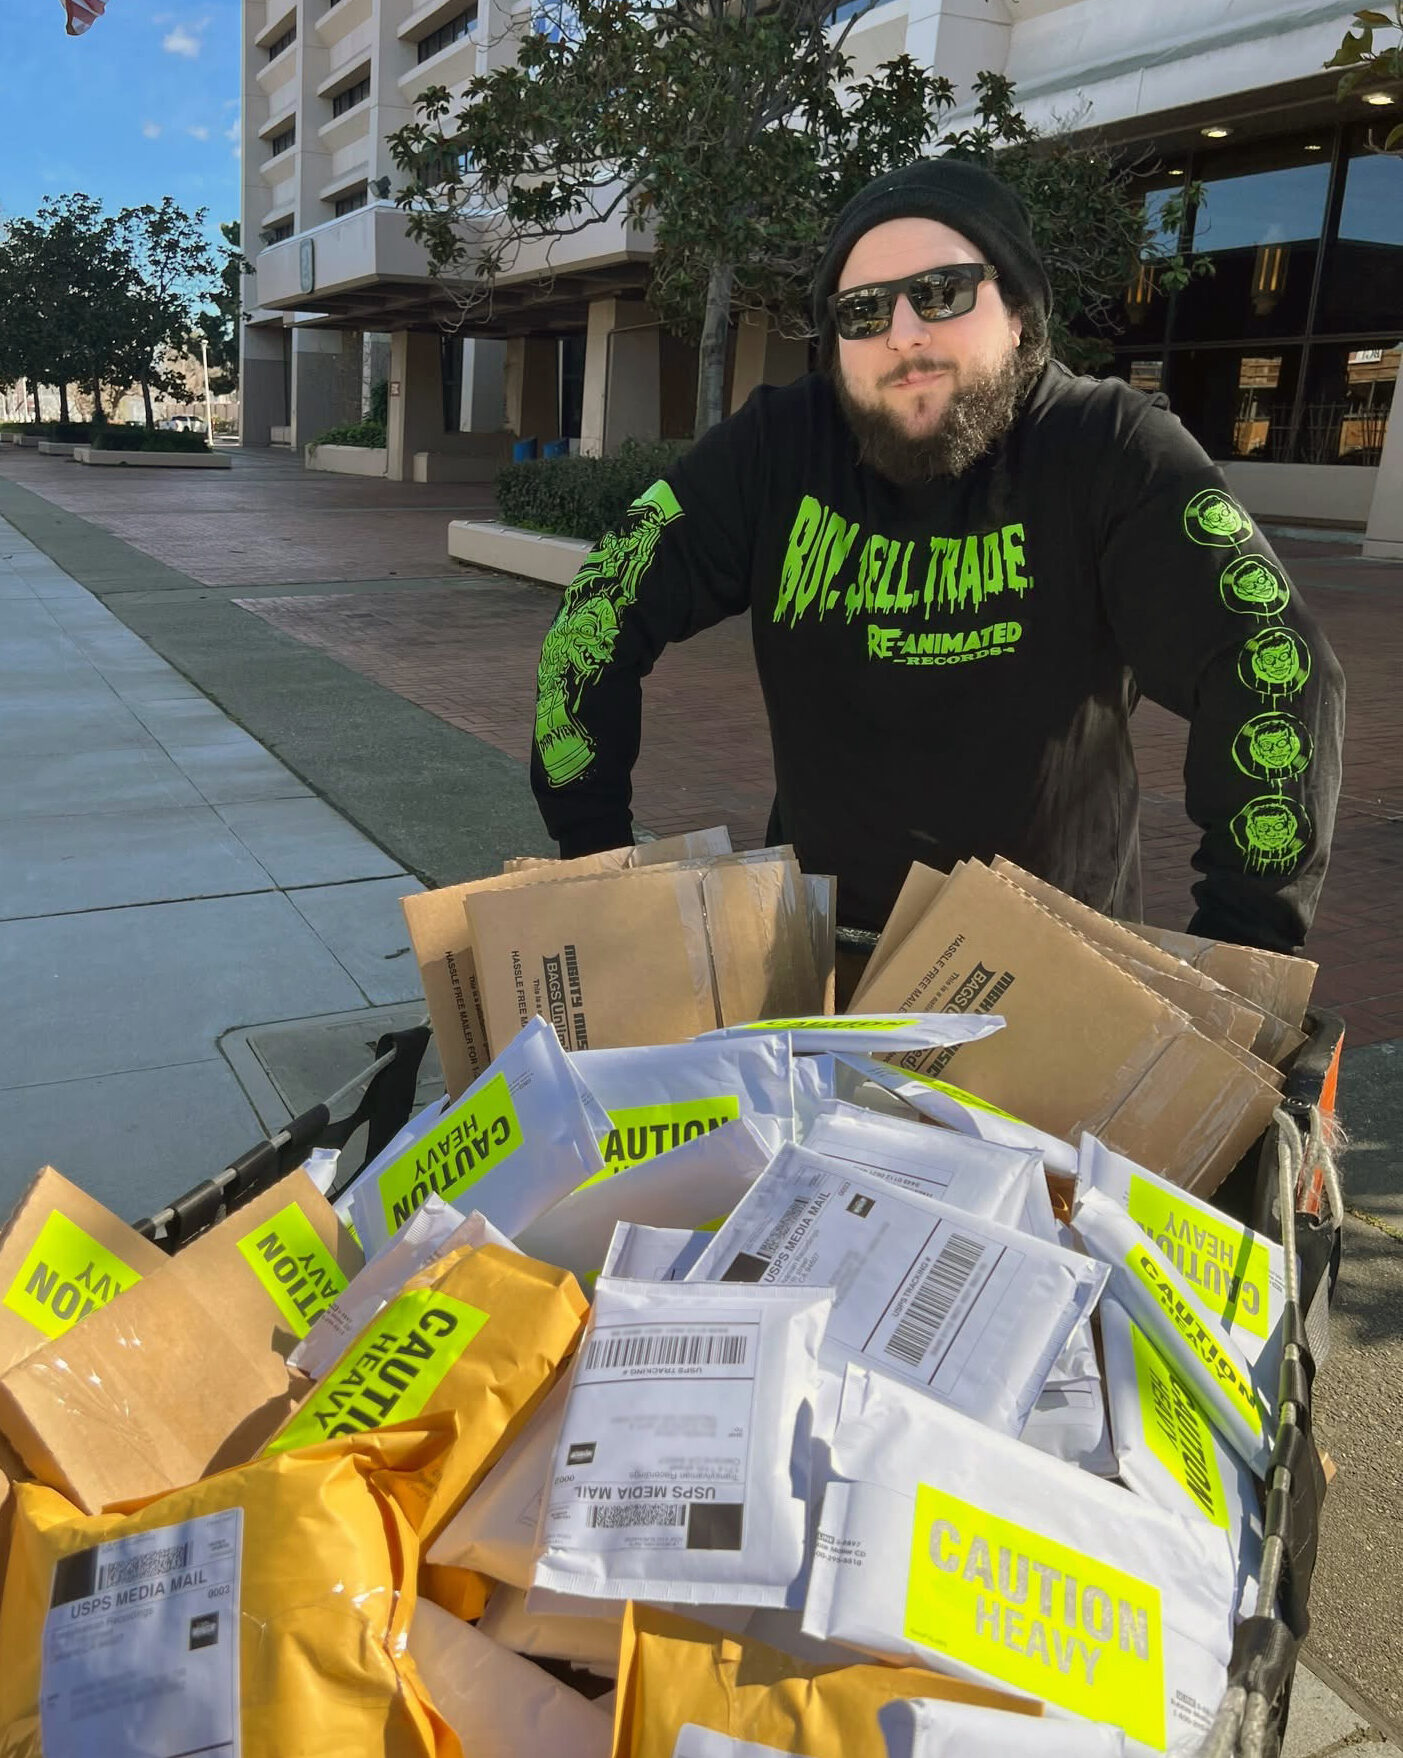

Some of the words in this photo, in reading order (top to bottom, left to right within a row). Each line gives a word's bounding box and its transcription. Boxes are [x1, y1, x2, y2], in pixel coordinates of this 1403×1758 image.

[773, 495, 860, 629] BUY.
[846, 534, 918, 625] SELL.
[924, 523, 1034, 619] TRADE.
[867, 621, 1022, 661] RE-ANIMATED
[906, 646, 1001, 666] RECORDS
[445, 950, 461, 985] HASSLE
[511, 950, 524, 988] HASSLE
[938, 933, 966, 969] HASSLE
[546, 962, 562, 1001] BAGS
[564, 945, 583, 1008] MIGHTY
[919, 966, 940, 991] FREE
[954, 970, 987, 1006] BAGS
[977, 971, 1016, 1014] MIGH
[453, 986, 466, 1011] FREE
[517, 989, 528, 1014] FREE
[899, 986, 923, 1013] MAILE
[459, 1011, 474, 1044] MAILER
[551, 1002, 570, 1050] Unlim
[573, 1012, 589, 1050] MUS
[468, 1045, 479, 1064] FOR
[414, 1114, 479, 1181] HEAVY
[604, 1116, 728, 1162] AUTIO
[393, 1115, 512, 1229] CAUTION
[764, 1252, 790, 1283] USPS
[785, 1217, 814, 1252] MEDIA
[808, 1191, 831, 1216] MAIL
[1165, 1211, 1234, 1268] HEAVY
[297, 1253, 339, 1299] AVY
[892, 1297, 908, 1317] USPS
[903, 1262, 928, 1297] TRACKING
[1140, 1256, 1257, 1410] CAUTION
[313, 1333, 399, 1431] HEAVY
[327, 1308, 458, 1439] CAUTIO
[630, 1367, 676, 1376] TRACKING
[678, 1367, 703, 1375] USPS
[1149, 1367, 1178, 1451] HEAVY
[1169, 1373, 1216, 1517] CAUTION
[575, 1485, 612, 1500] MAIL
[618, 1486, 667, 1500] MEDIA
[673, 1486, 716, 1500] USPS
[70, 1595, 112, 1619] USPS
[116, 1583, 165, 1607] MEDIA
[170, 1573, 208, 1592] MAIL
[928, 1518, 1149, 1662] CAUTION
[975, 1594, 1102, 1686] HEAVY
